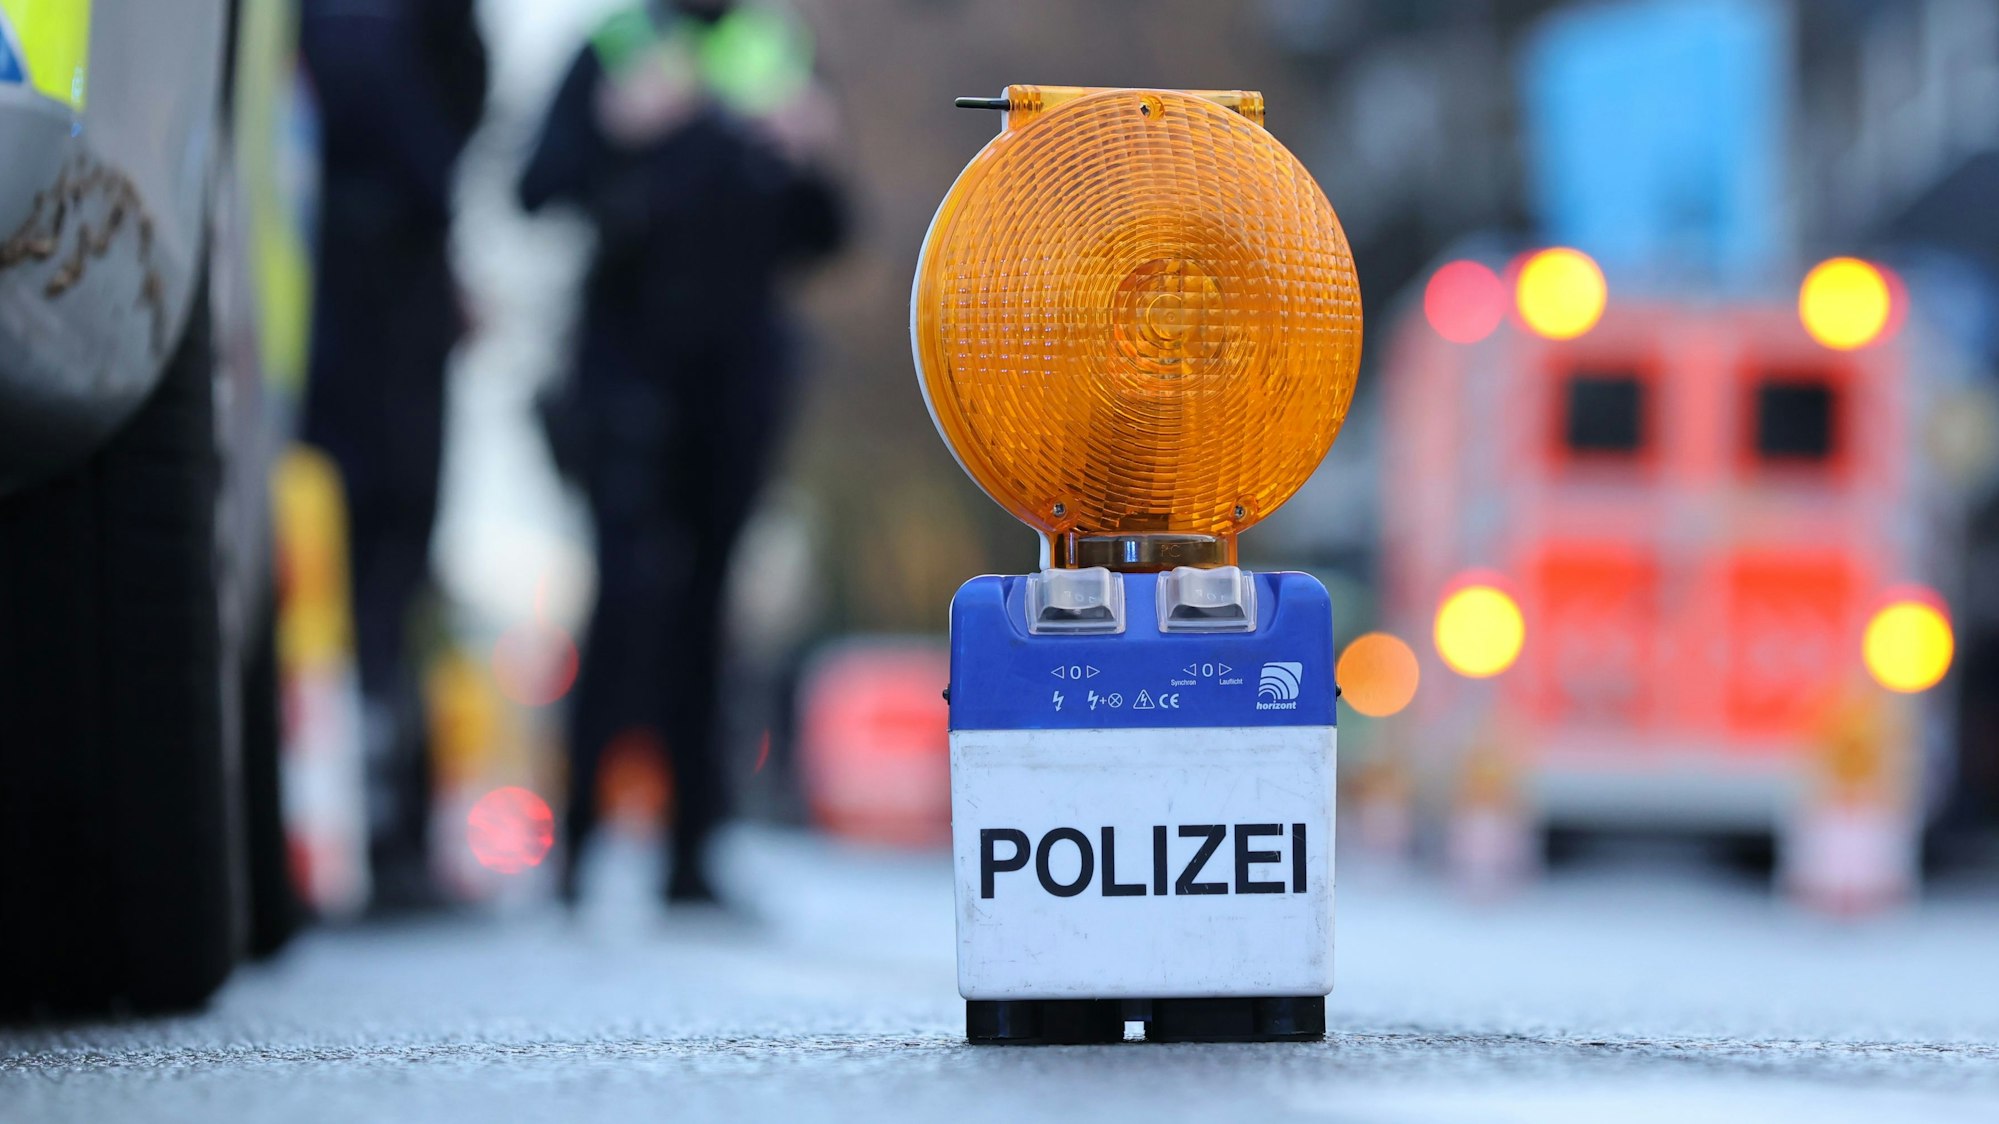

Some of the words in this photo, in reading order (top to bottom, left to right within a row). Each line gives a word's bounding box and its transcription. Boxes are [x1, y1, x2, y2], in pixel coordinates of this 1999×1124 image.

[1170, 679, 1197, 687] Synchron
[1159, 693, 1180, 709] CE
[1256, 700, 1297, 710] horizont
[980, 823, 1307, 899] POLIZEI
